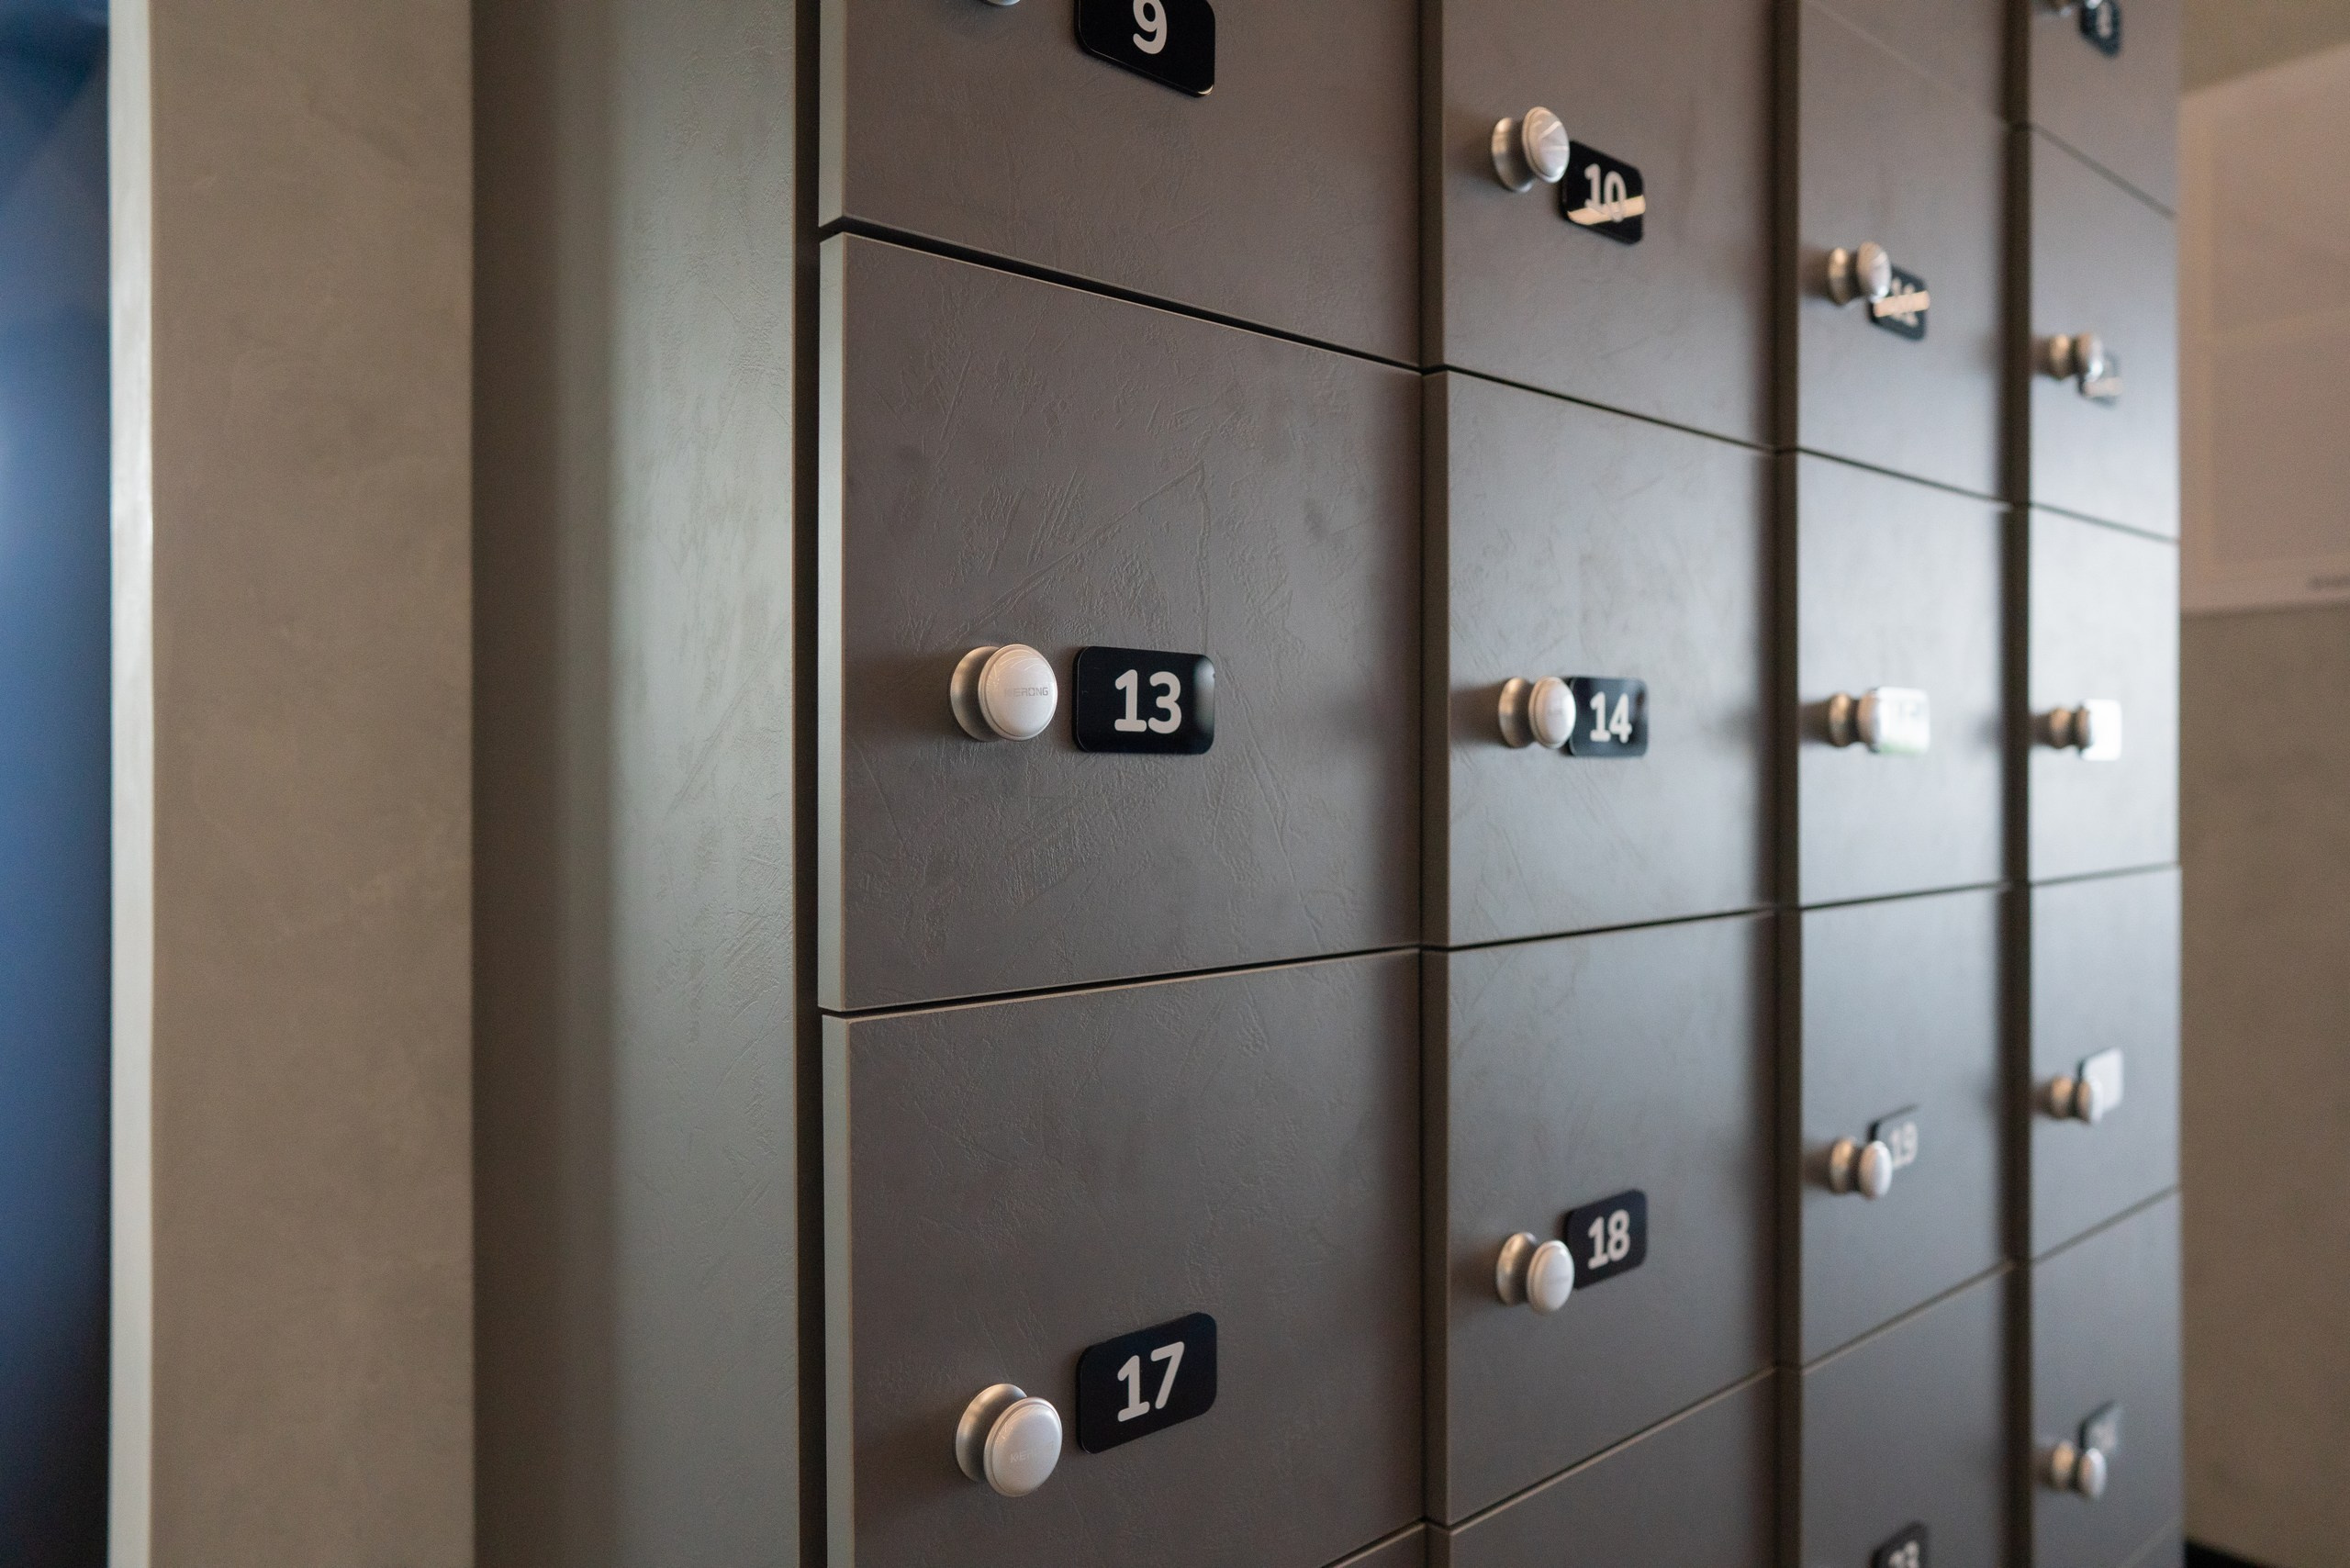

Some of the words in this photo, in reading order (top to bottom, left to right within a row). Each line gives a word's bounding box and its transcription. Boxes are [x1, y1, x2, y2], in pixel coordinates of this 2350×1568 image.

[1133, 0, 1167, 54] 9
[1584, 163, 1627, 222] 10
[1114, 669, 1182, 734] 13
[1590, 691, 1632, 744] 14
[1588, 1209, 1630, 1270] 18
[1117, 1341, 1185, 1422] 17
